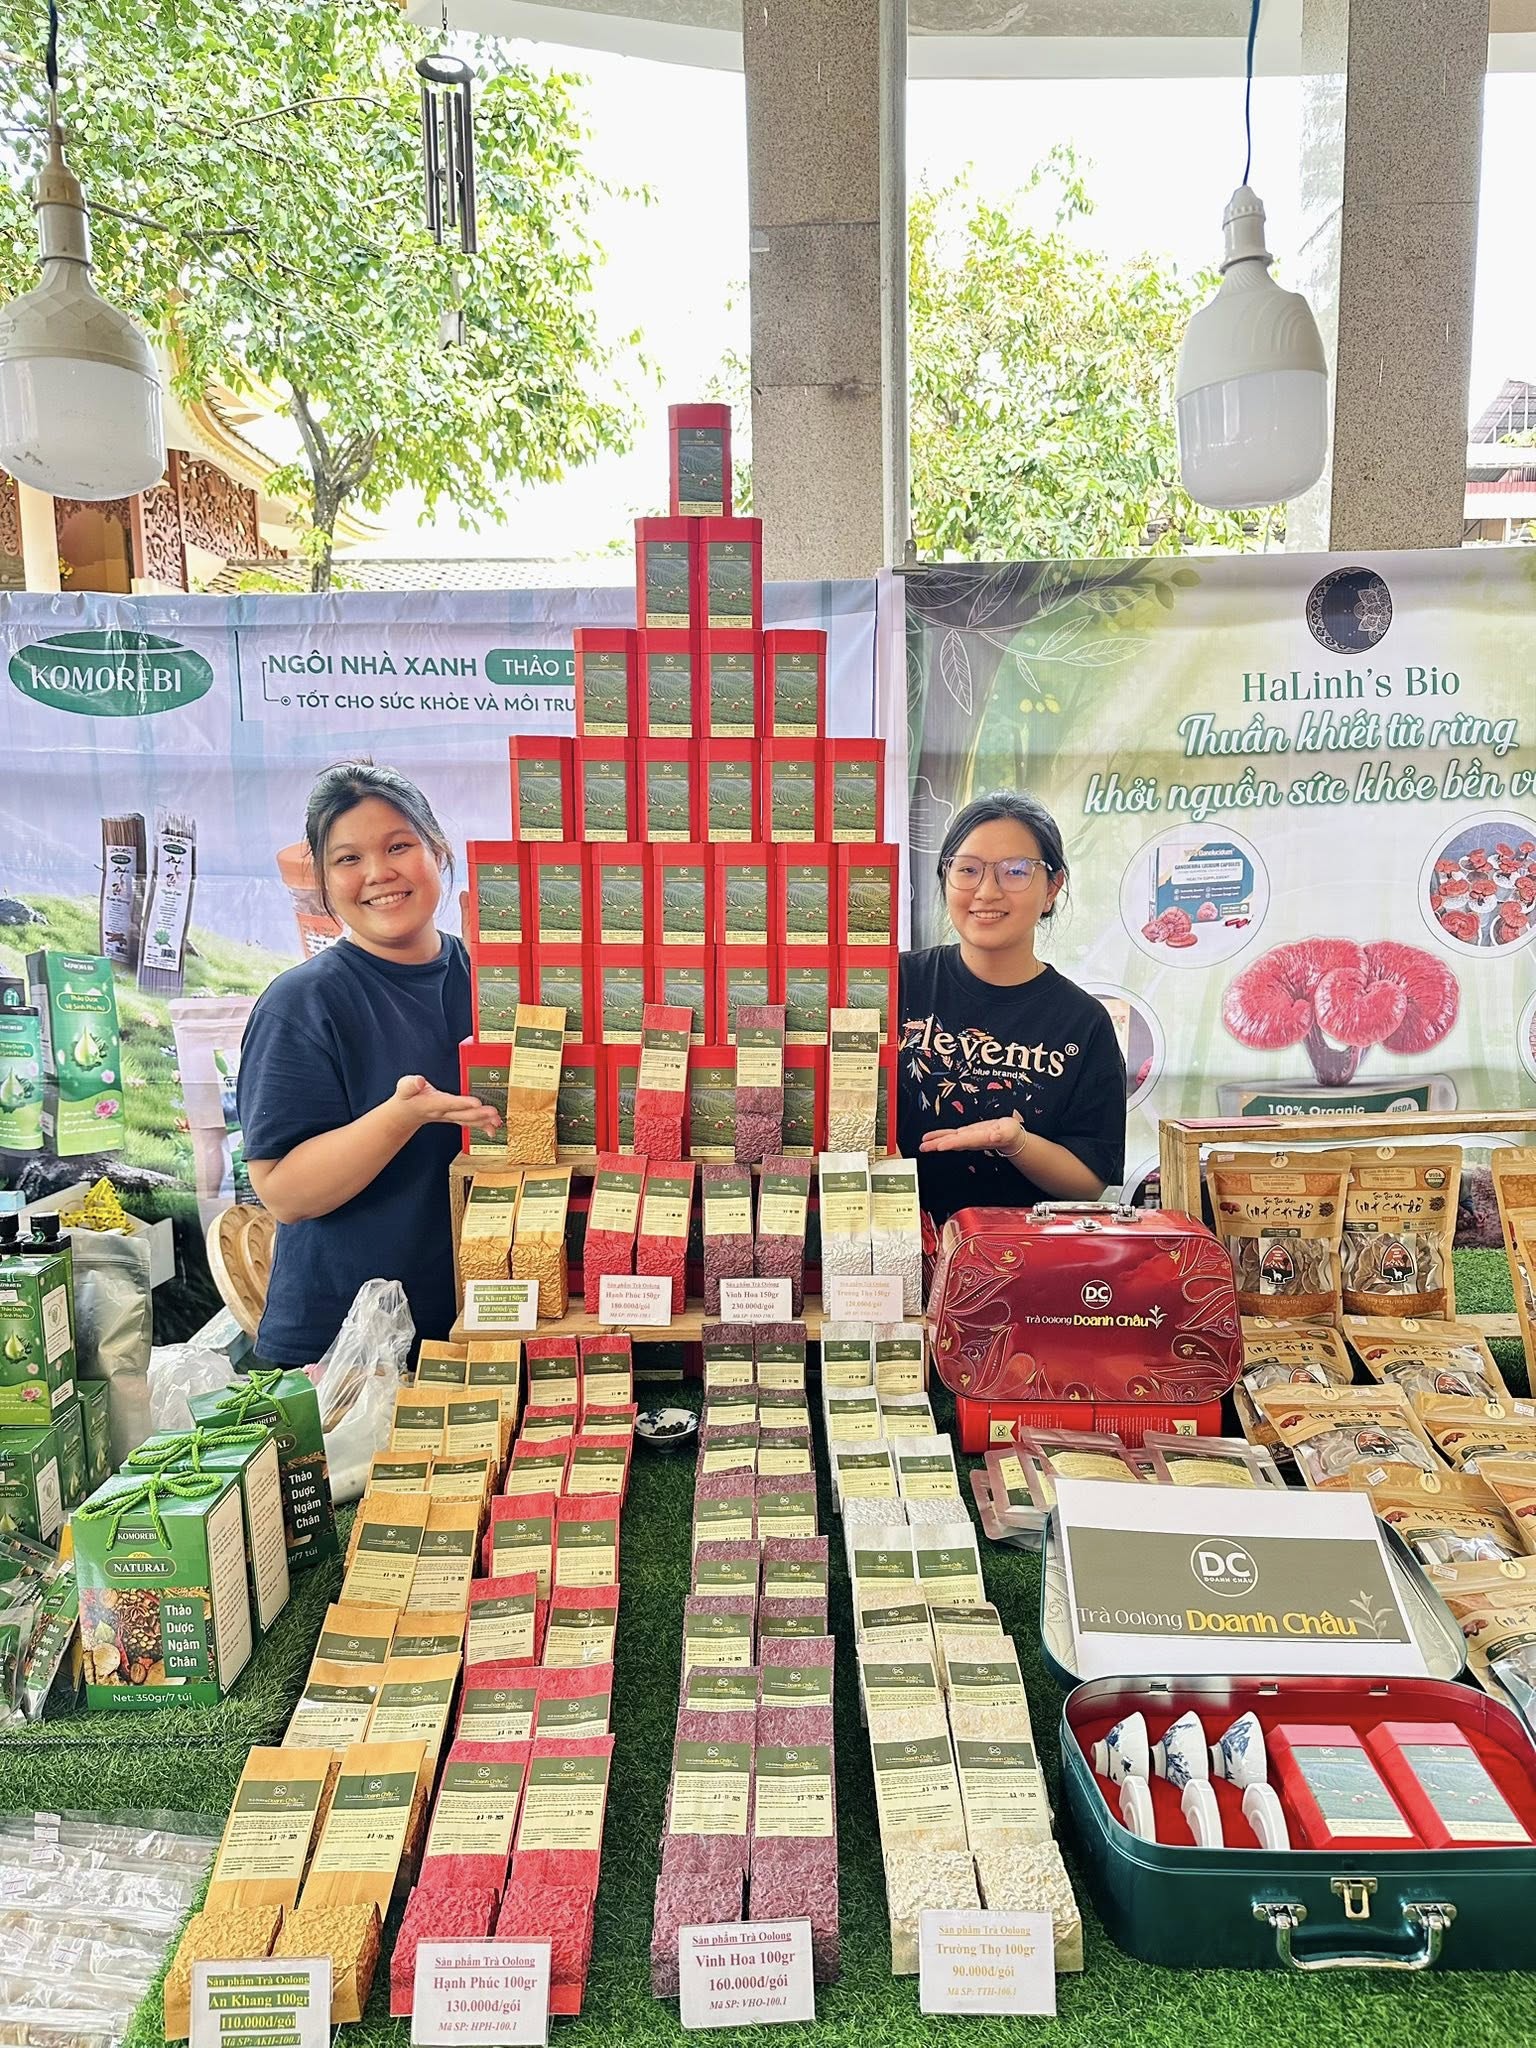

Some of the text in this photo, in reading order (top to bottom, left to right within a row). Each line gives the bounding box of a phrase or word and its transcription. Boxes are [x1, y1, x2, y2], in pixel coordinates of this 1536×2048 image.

[268, 650, 477, 678] NGÔI NHÀ XANH
[502, 655, 558, 677] THẢO
[31, 664, 182, 693] KOMOREBI
[1242, 665, 1461, 703] HaLinh's Bio
[296, 689, 333, 709] TỐT
[334, 694, 375, 710] CHO
[380, 691, 416, 711] SỨC
[420, 693, 469, 712] KHỎE
[474, 690, 499, 712] VÀ
[504, 692, 539, 712] MÔI
[1178, 708, 1518, 757] Thuần khiết từ rừng
[1083, 774, 1161, 815] khởi
[1167, 768, 1282, 822] nguồn
[1288, 772, 1348, 805] sức
[1354, 763, 1438, 805] khỏe
[1442, 758, 1506, 800] bền
[972, 1067, 990, 1077] blue
[1267, 1103, 1305, 1116] 100%
[760, 1291, 779, 1299] 150gr
[1085, 1286, 1109, 1300] DC
[1025, 1313, 1149, 1327] Trà Oolong Doanh Châu
[288, 1470, 313, 1485] Thảo
[291, 1485, 316, 1500] Dược
[293, 1498, 322, 1515] Ngâm
[117, 1532, 157, 1540] KOMOREBI
[113, 1563, 169, 1573] NATURAL
[1197, 1551, 1252, 1578] DC
[1204, 1575, 1254, 1585] DOANH CHÂU
[164, 1603, 192, 1616] Thảo
[1076, 1605, 1359, 1636] Trà Oolong Doanh Châu
[166, 1622, 195, 1635] Dược
[168, 1638, 200, 1652] Ngâm
[169, 1656, 197, 1668] Chân
[112, 1692, 192, 1703] Net: 350gr/7 túi
[983, 1925, 998, 1934] Trà
[1000, 1925, 1031, 1936] Oolong
[692, 1931, 792, 1946] Sản phẩm Trà Oolong
[980, 1943, 1001, 1957] Thọ
[1005, 1943, 1036, 1957] 100gr
[435, 1954, 536, 1969] Sản phẩm Trà Oolong
[695, 1950, 796, 1968] Vinh Hoa 100gr
[952, 1964, 1015, 1980] 90.000đ/gói
[256, 1975, 273, 1986] Trà
[275, 1974, 309, 1985] Oolong
[433, 1975, 538, 1992] Hạnh Phúc 100gr
[709, 1974, 788, 1991] 160.000đ/gói
[209, 1992, 310, 2008] An Khang 100gr
[446, 1999, 521, 2015] 130.000đ/gói
[709, 1997, 787, 2010] Mã SP: VHO-100.1
[221, 2014, 296, 2029] 110.000đ/gói
[438, 2021, 517, 2032] Mã SP: HPH-100.1
[236, 2036, 253, 2047] SP:
